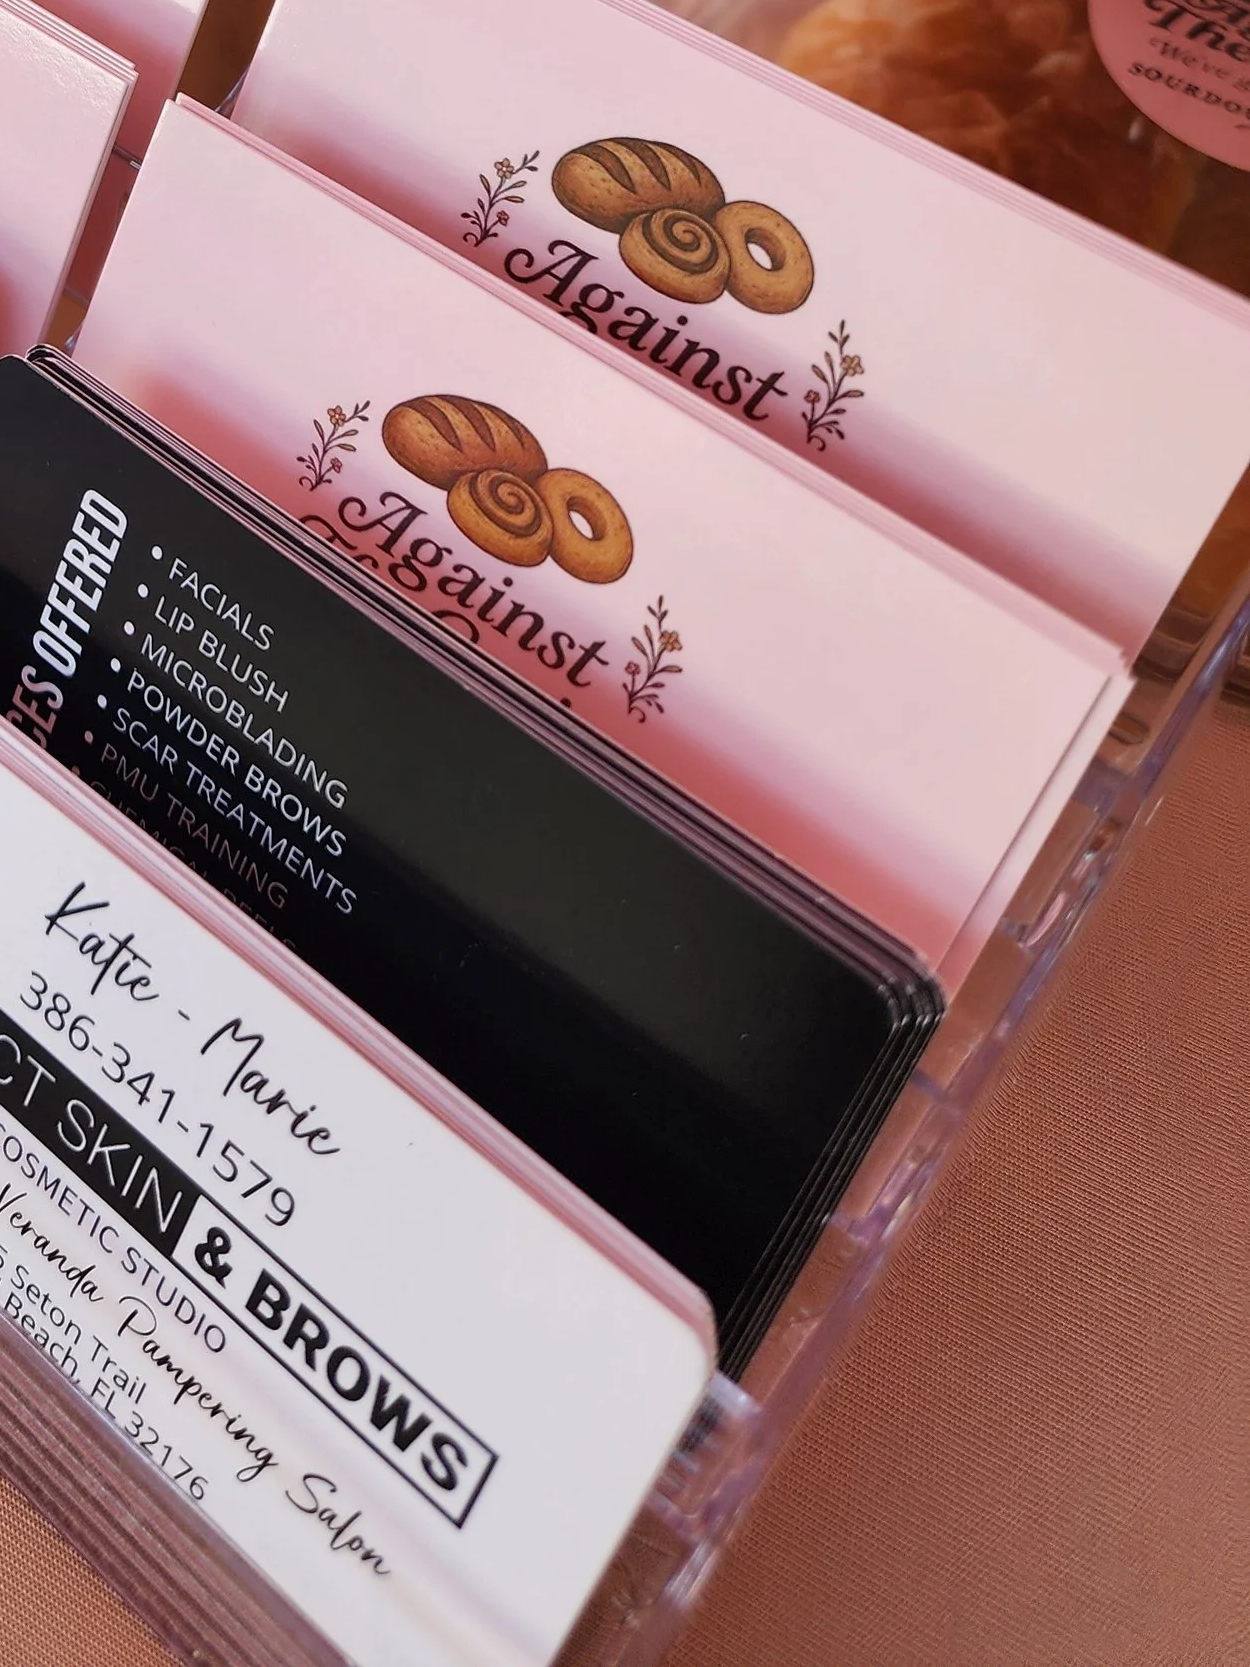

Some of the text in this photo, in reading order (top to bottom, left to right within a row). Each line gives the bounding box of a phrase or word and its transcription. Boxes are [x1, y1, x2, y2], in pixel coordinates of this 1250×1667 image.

[504, 237, 790, 422] Against
[32, 489, 128, 678] OFFERED
[154, 595, 290, 714] LIP BLUSH
[167, 557, 275, 652] FACIALS
[338, 491, 609, 688] Against
[112, 707, 179, 775] SCAR
[185, 760, 358, 915] TREATMENTS
[126, 669, 241, 777] POWDER
[243, 763, 348, 858] BROWS
[140, 633, 350, 810] MICROBLADING
[100, 742, 159, 801] PMU
[166, 793, 288, 910] TRAINING
[20, 970, 296, 1227] 386-341-1579
[44, 881, 160, 1002] Katie
[199, 1018, 341, 1155] Marie
[9, 1264, 82, 1346] Seton
[90, 1335, 147, 1405] Trail
[56, 1098, 183, 1235] SKIN
[194, 1225, 232, 1289] &
[245, 1268, 472, 1493] BROWS
[120, 1246, 227, 1354] STUDIO
[90, 1378, 117, 1419] FL
[124, 1411, 209, 1501] 32176
[117, 1295, 279, 1483] Pampering
[285, 1472, 392, 1576] Salon
